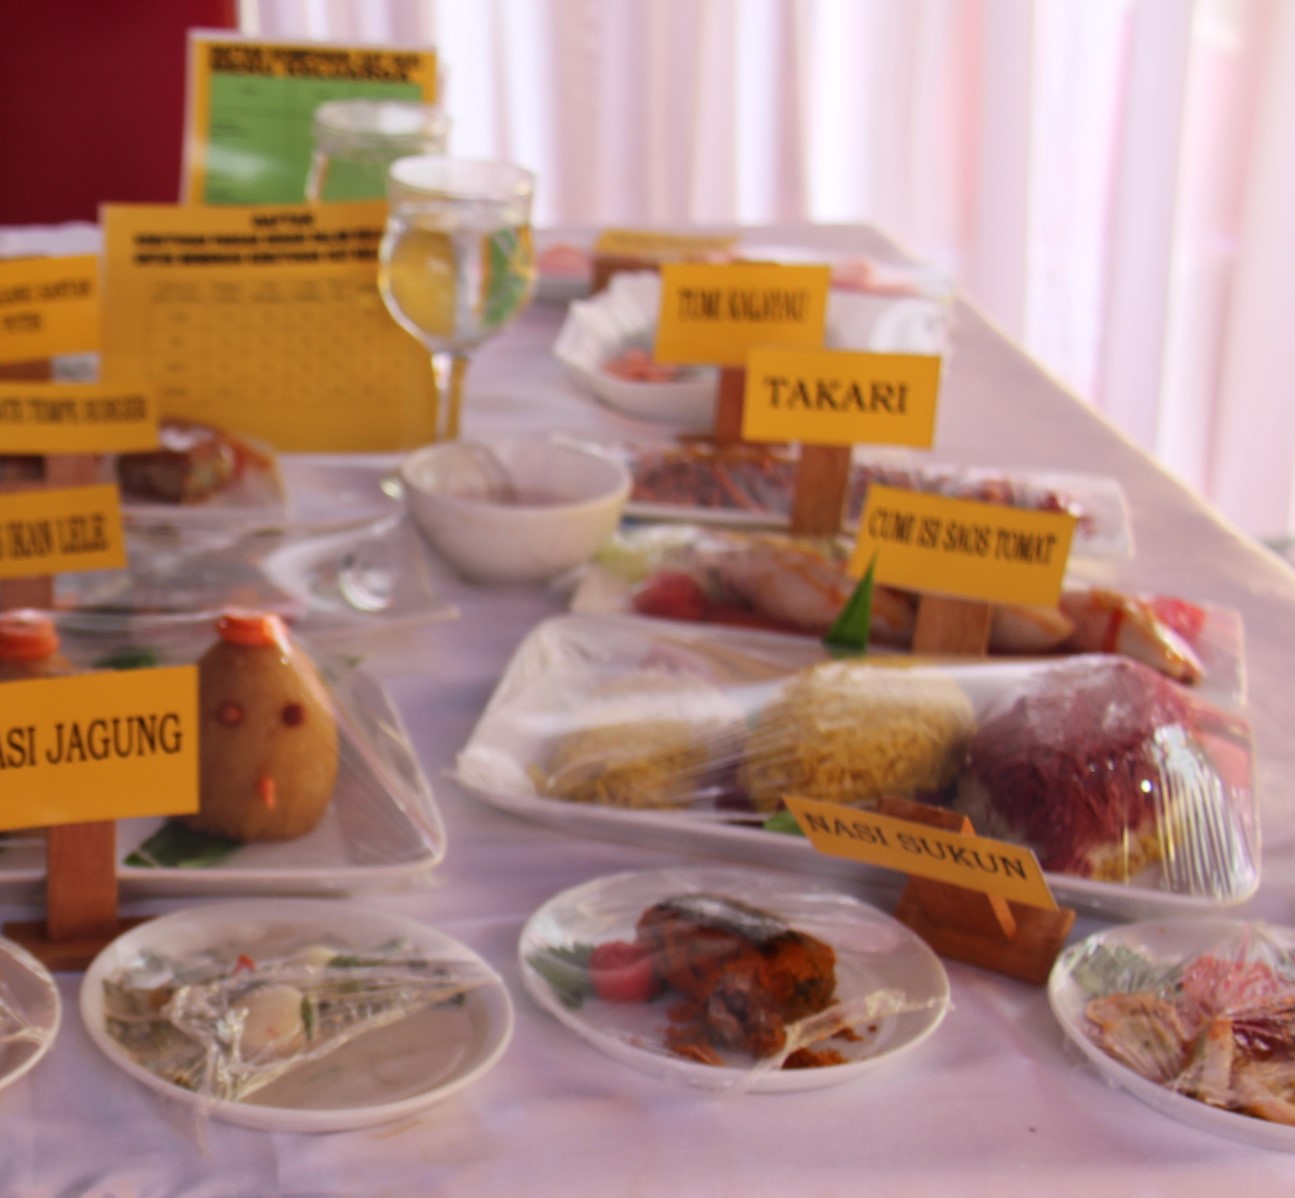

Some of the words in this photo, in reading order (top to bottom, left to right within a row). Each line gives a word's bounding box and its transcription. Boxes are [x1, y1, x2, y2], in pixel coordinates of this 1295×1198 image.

[763, 375, 912, 415] TAKARI
[5, 519, 54, 559] IKAN
[56, 512, 108, 555] LELE
[867, 505, 916, 545] CUMI
[917, 517, 943, 549] ISI
[943, 521, 992, 557] SAOS
[994, 527, 1058, 567] TOMAT
[46, 712, 183, 765] JAGUNG
[804, 811, 889, 847] NASI
[897, 832, 1027, 880] SUKUN
